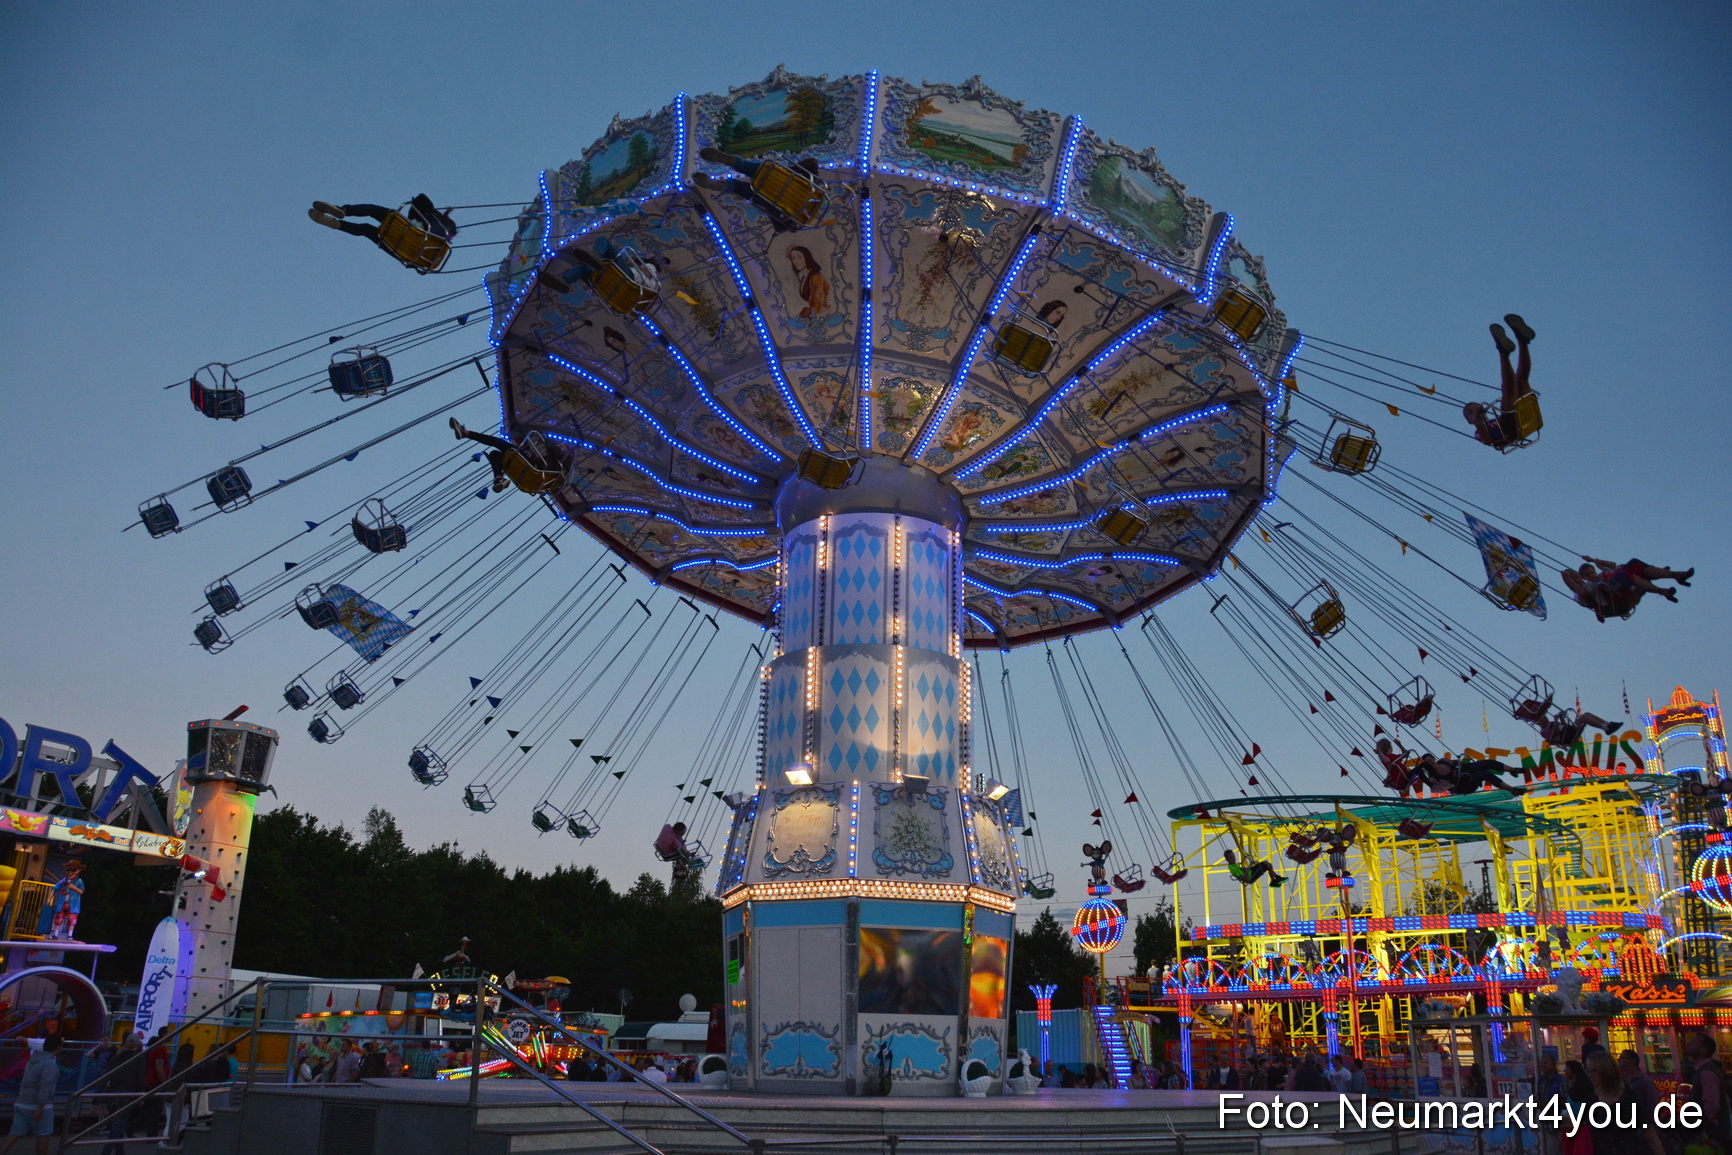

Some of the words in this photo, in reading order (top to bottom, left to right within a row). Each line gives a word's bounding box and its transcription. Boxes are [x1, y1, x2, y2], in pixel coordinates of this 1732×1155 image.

[1515, 730, 1647, 798] MAUS
[52, 817, 68, 827] Fat
[114, 836, 131, 847] Bull
[147, 954, 176, 966] Delta
[136, 965, 173, 1032] AIRPORT
[1604, 984, 1687, 1004] Kasse
[510, 1020, 529, 1034] JUMBO
[511, 1031, 525, 1040] JET
[1498, 1082, 1513, 1094] 112
